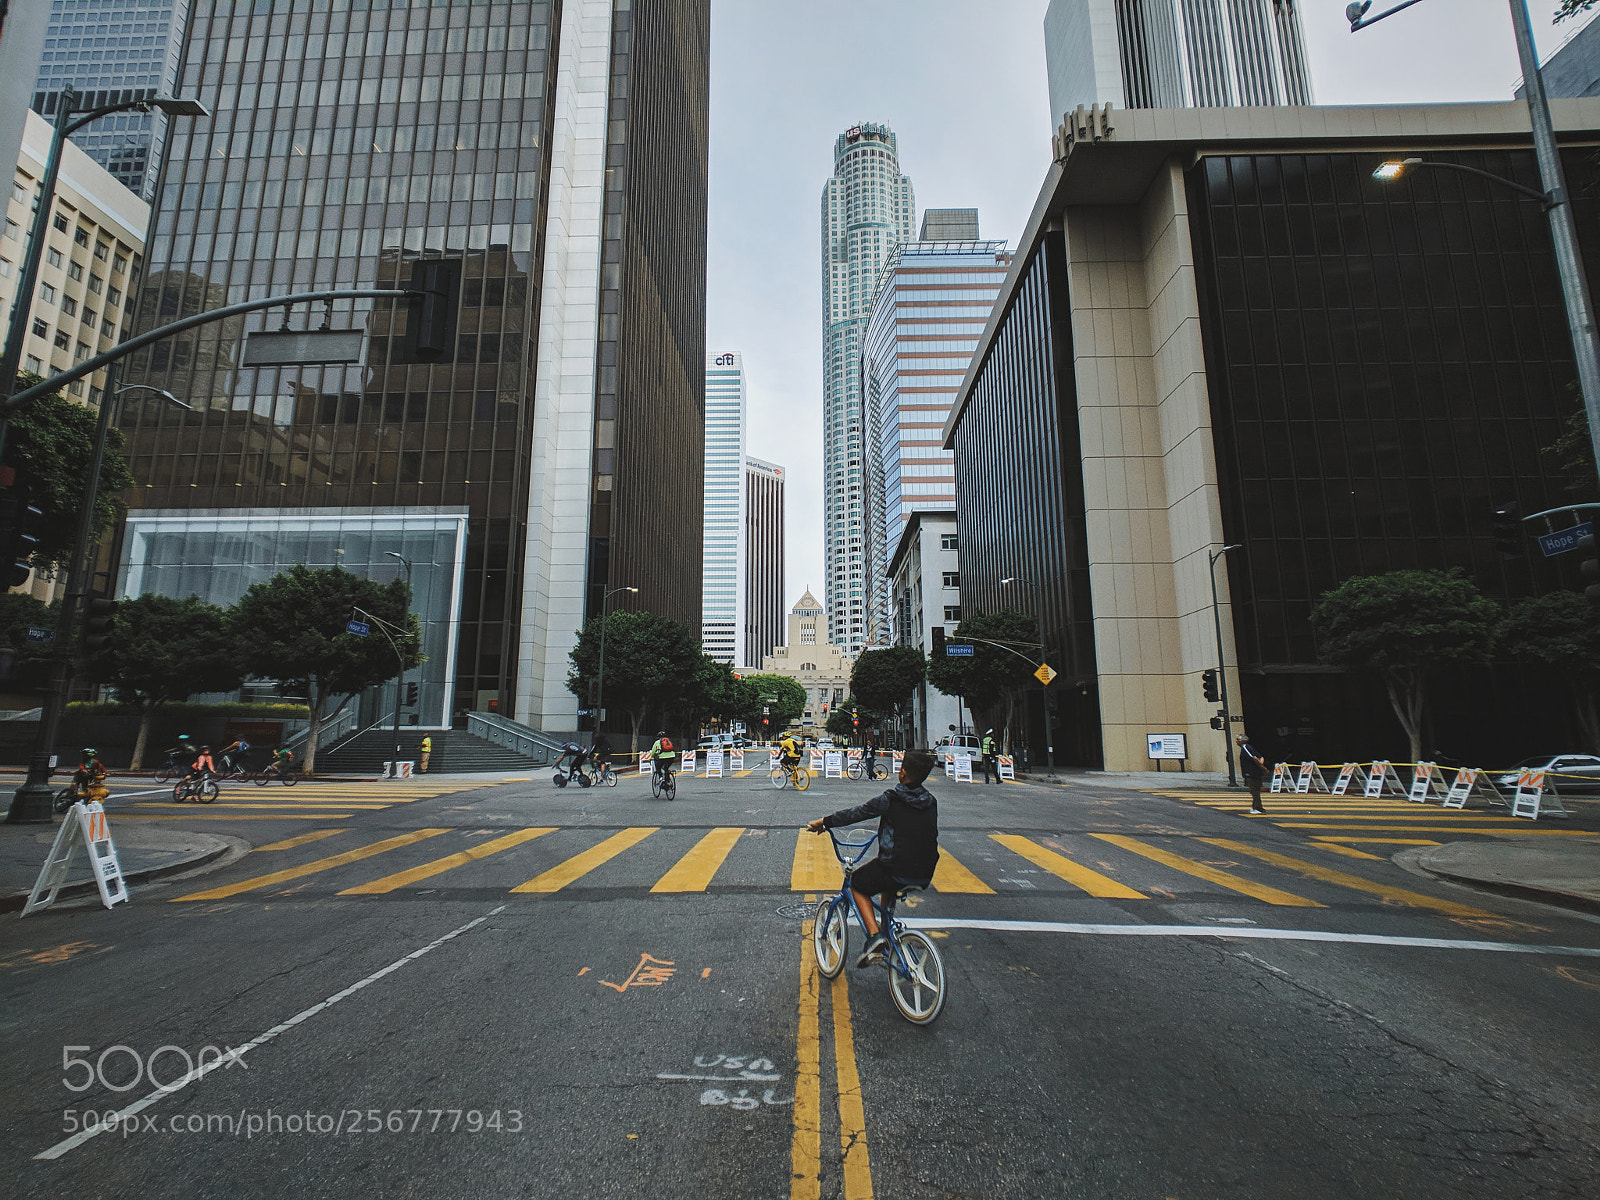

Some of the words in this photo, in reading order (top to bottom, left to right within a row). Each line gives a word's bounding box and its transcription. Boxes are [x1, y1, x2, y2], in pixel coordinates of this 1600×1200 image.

[846, 127, 860, 138] us
[715, 353, 734, 366] citi
[1546, 535, 1574, 550] Hope
[693, 1054, 775, 1071] USA
